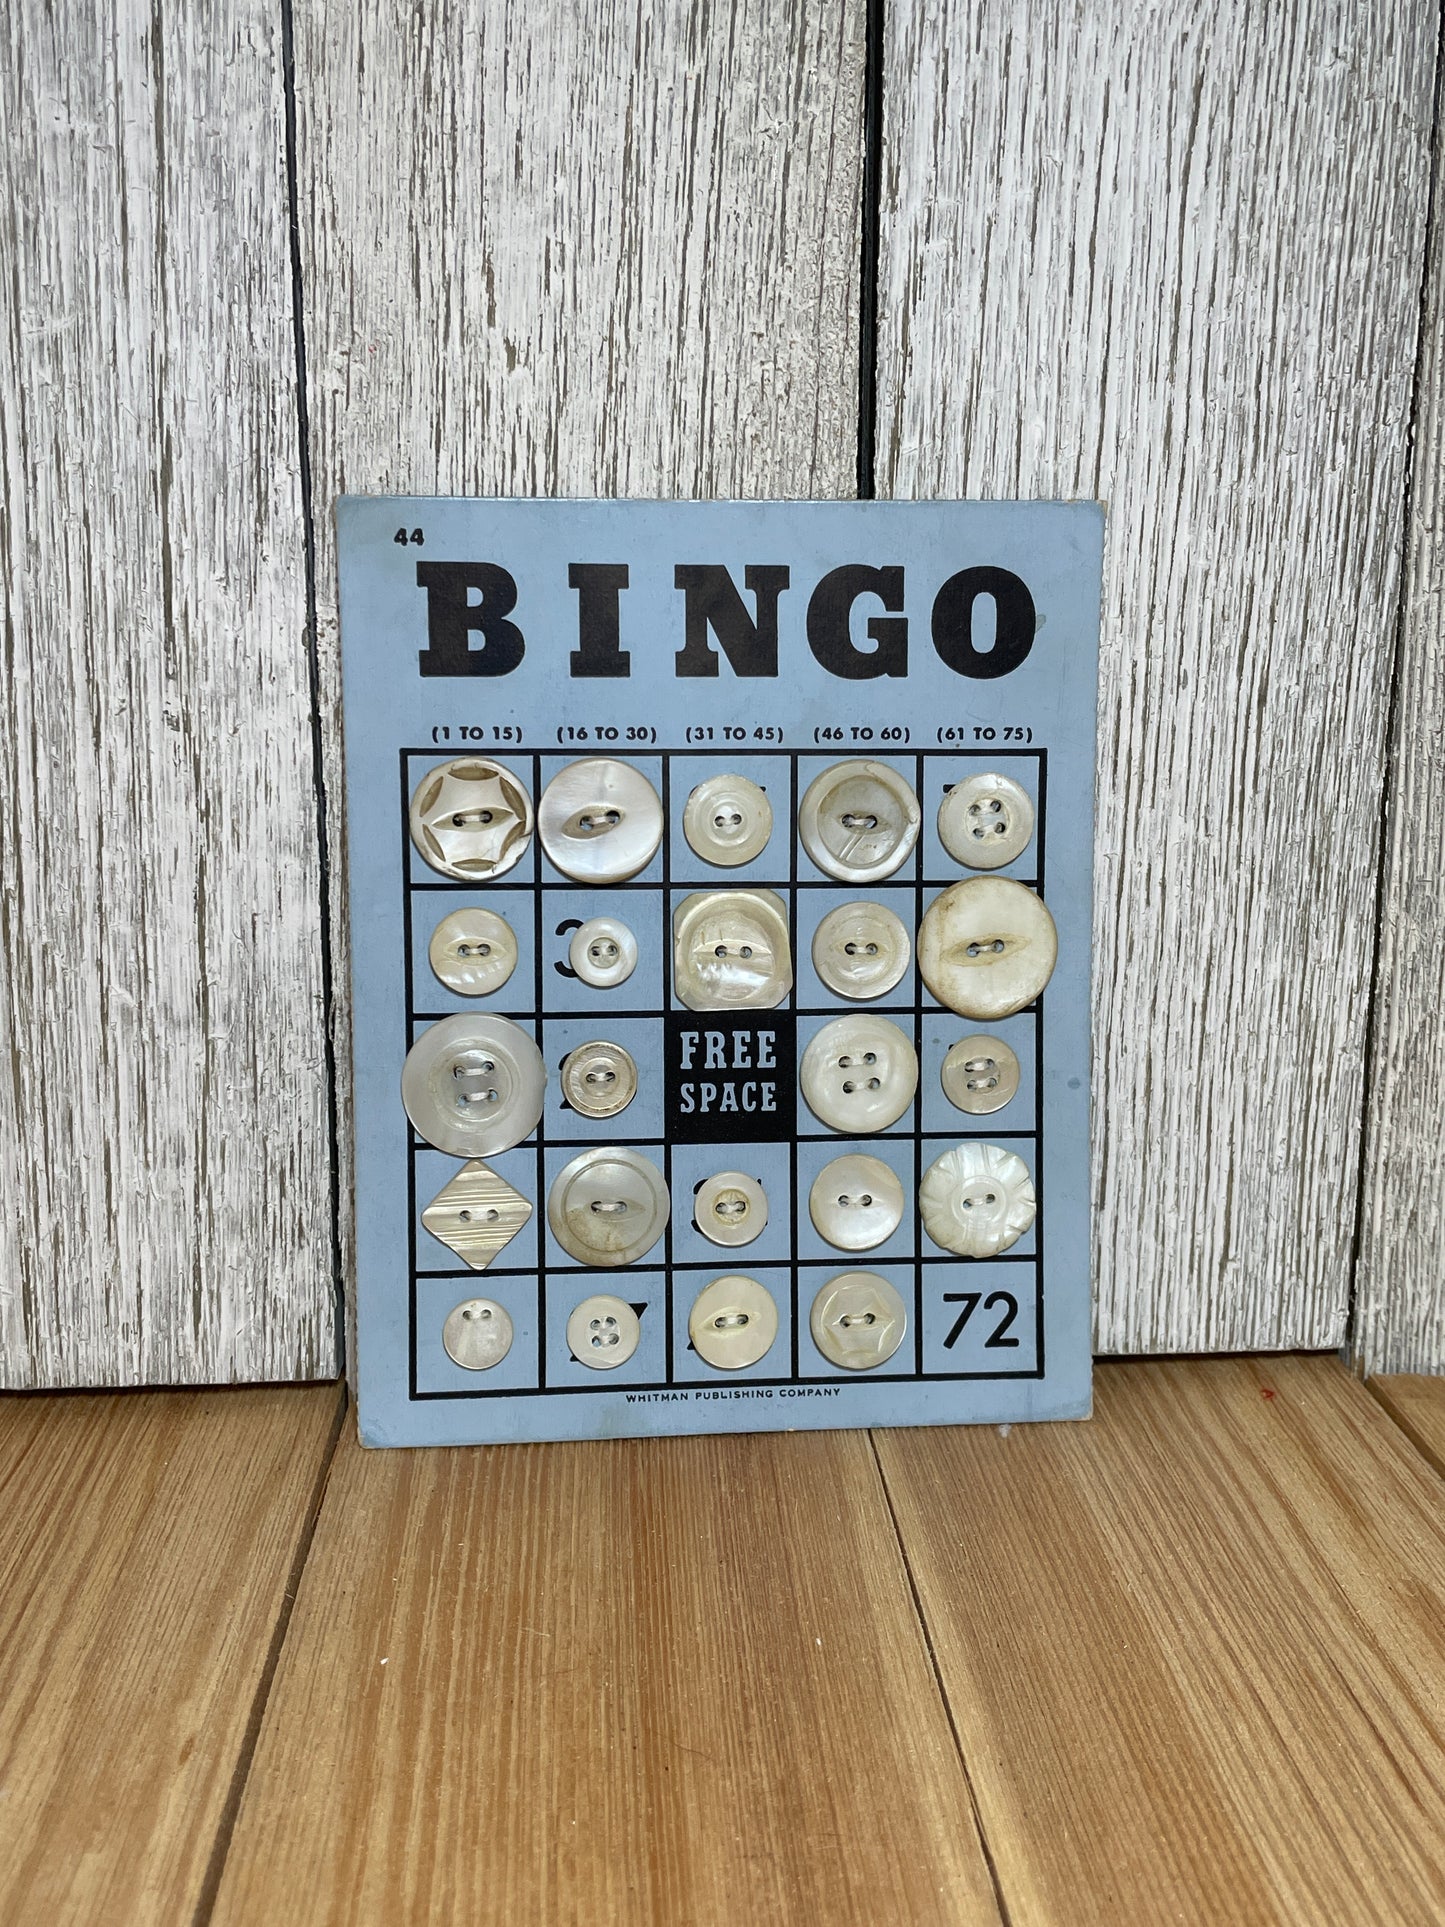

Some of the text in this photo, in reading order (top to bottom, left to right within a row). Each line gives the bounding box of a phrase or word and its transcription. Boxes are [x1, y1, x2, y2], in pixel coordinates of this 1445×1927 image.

[393, 527, 425, 547] 44
[416, 560, 1037, 680] BINGO
[431, 726, 523, 744] (1 TO 15)
[556, 726, 657, 744] (16 TO 30)
[685, 726, 784, 744] (31 TO 45)
[813, 726, 911, 744] (46 TO 60)
[936, 726, 1033, 744] (61 TO 75)
[680, 1030, 777, 1070] FREE
[680, 1081, 777, 1114] SPACE
[943, 1290, 1020, 1349] 72
[625, 1387, 841, 1403] WHITMAN PUBLISHING COMPANY
